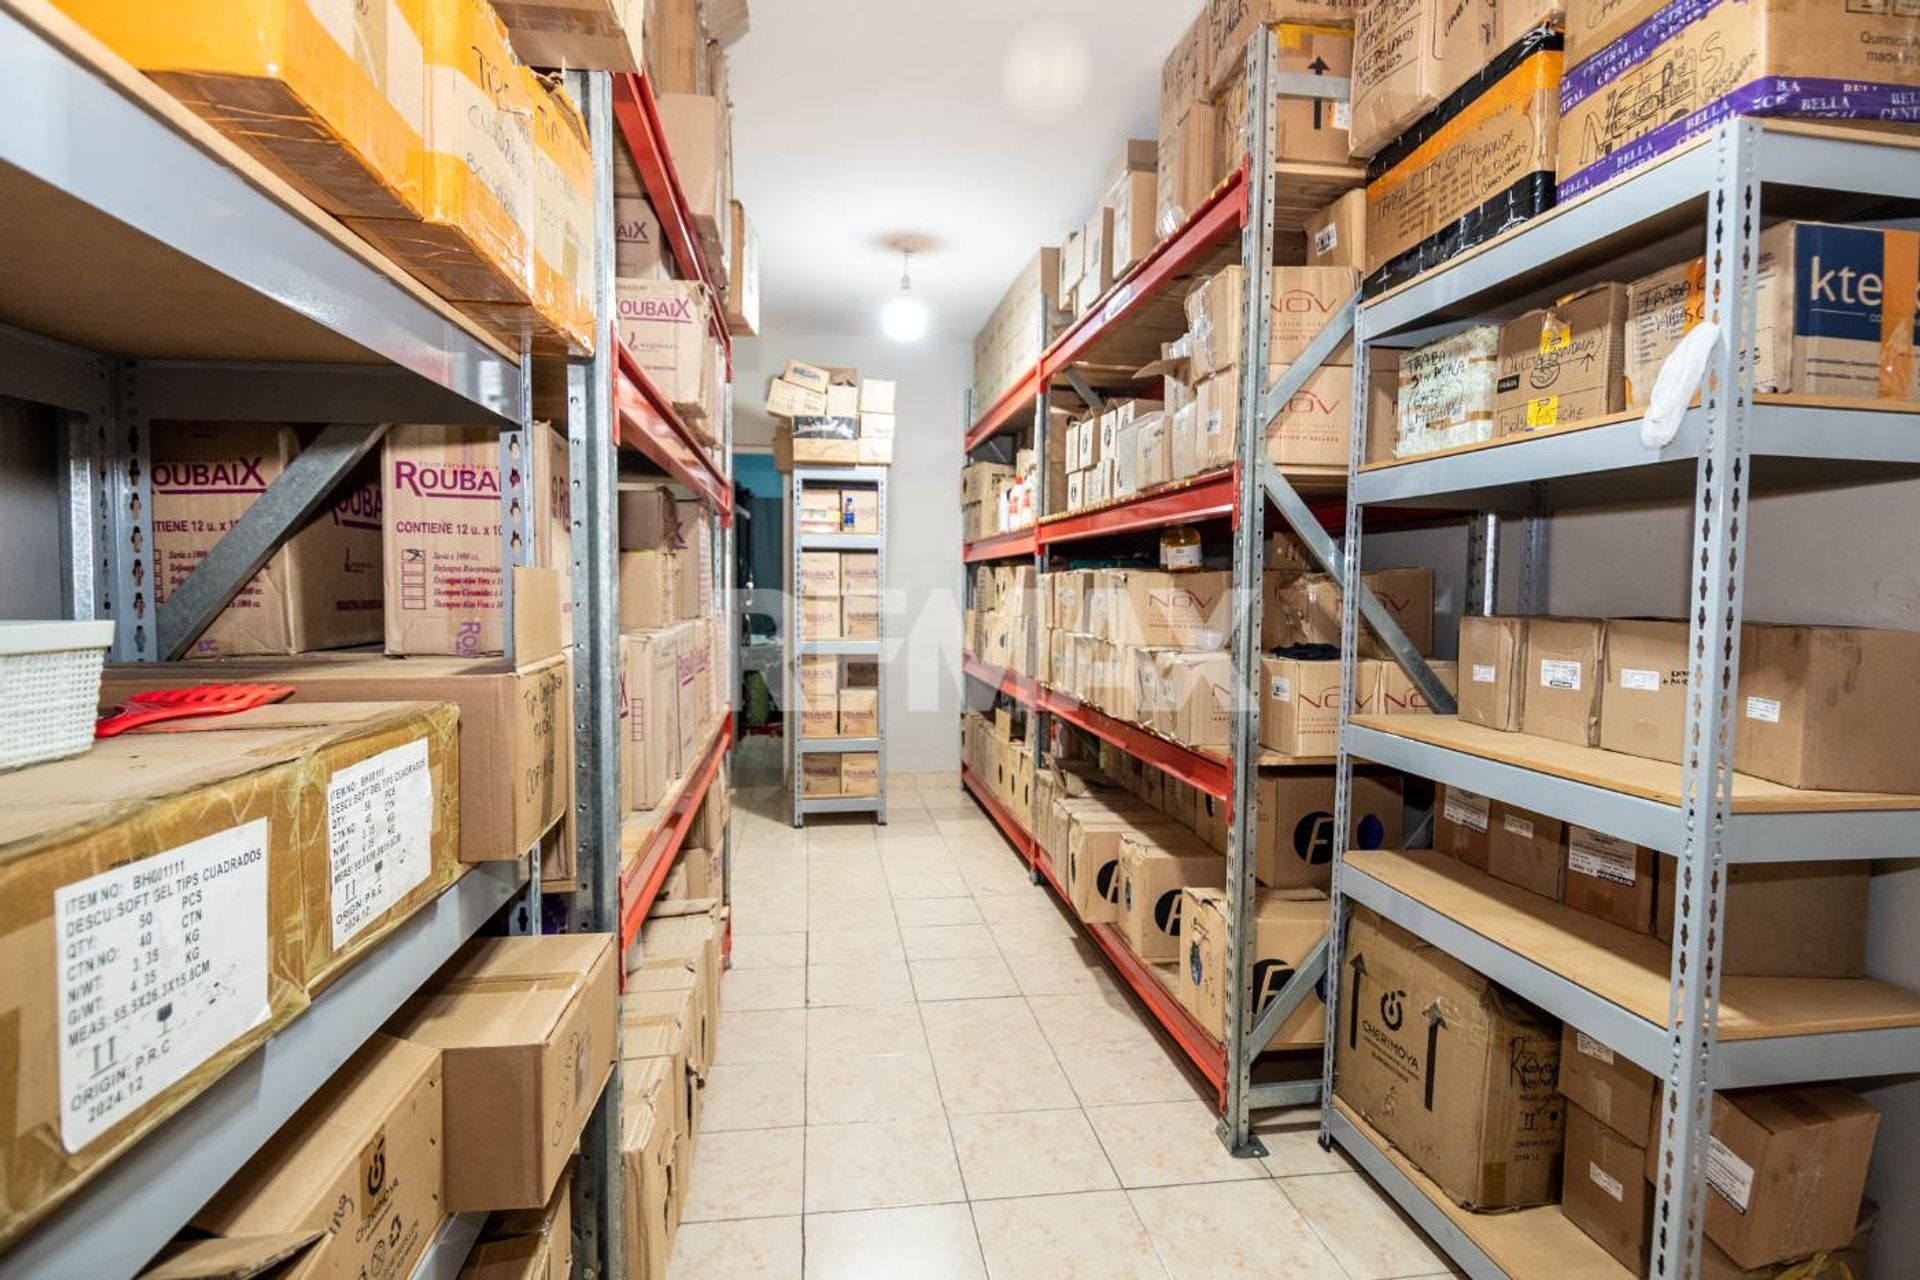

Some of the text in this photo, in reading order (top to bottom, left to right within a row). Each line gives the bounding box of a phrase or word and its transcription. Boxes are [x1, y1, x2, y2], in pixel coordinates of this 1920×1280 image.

[1685, 97, 1730, 131] BELLA
[1800, 96, 1850, 111] BELLA
[1616, 142, 1653, 168] BELLA
[616, 221, 648, 239] AIX
[1810, 256, 1882, 306] kte
[616, 299, 692, 320] OUBAIX
[152, 457, 266, 487] OUBAIX
[152, 520, 190, 533] TIENE
[396, 522, 453, 535] CONTIENE
[457, 524, 468, 535] 12
[154, 886, 174, 904] GEL
[176, 873, 200, 893] TIPS
[203, 848, 262, 882] CUADRADOS
[65, 892, 98, 915] ITEM
[139, 890, 203, 929] 50 PCS
[139, 909, 202, 948] 40 CTN
[185, 929, 200, 946] KG
[185, 946, 200, 964] KG
[67, 958, 97, 982] CTN
[1362, 1020, 1420, 1072] CHERIMOYA
